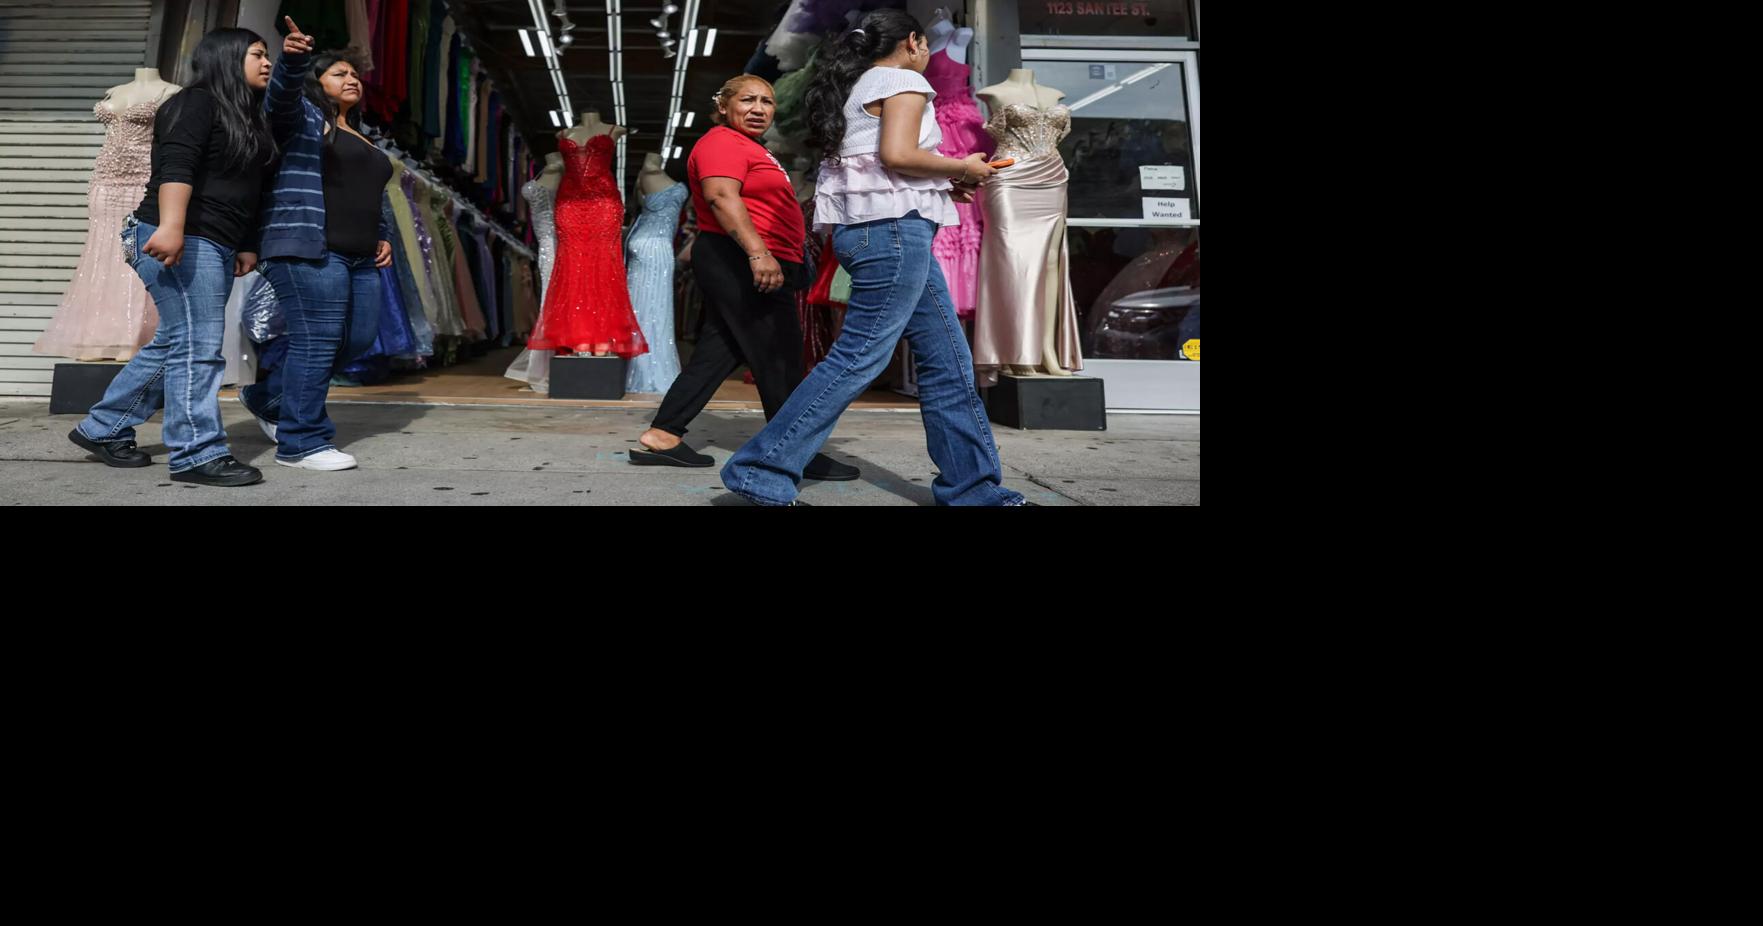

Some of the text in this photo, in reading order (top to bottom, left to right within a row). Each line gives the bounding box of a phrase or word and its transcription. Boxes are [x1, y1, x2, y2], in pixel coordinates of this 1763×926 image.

[1047, 2, 1151, 16] 1123 SANTEE ST.
